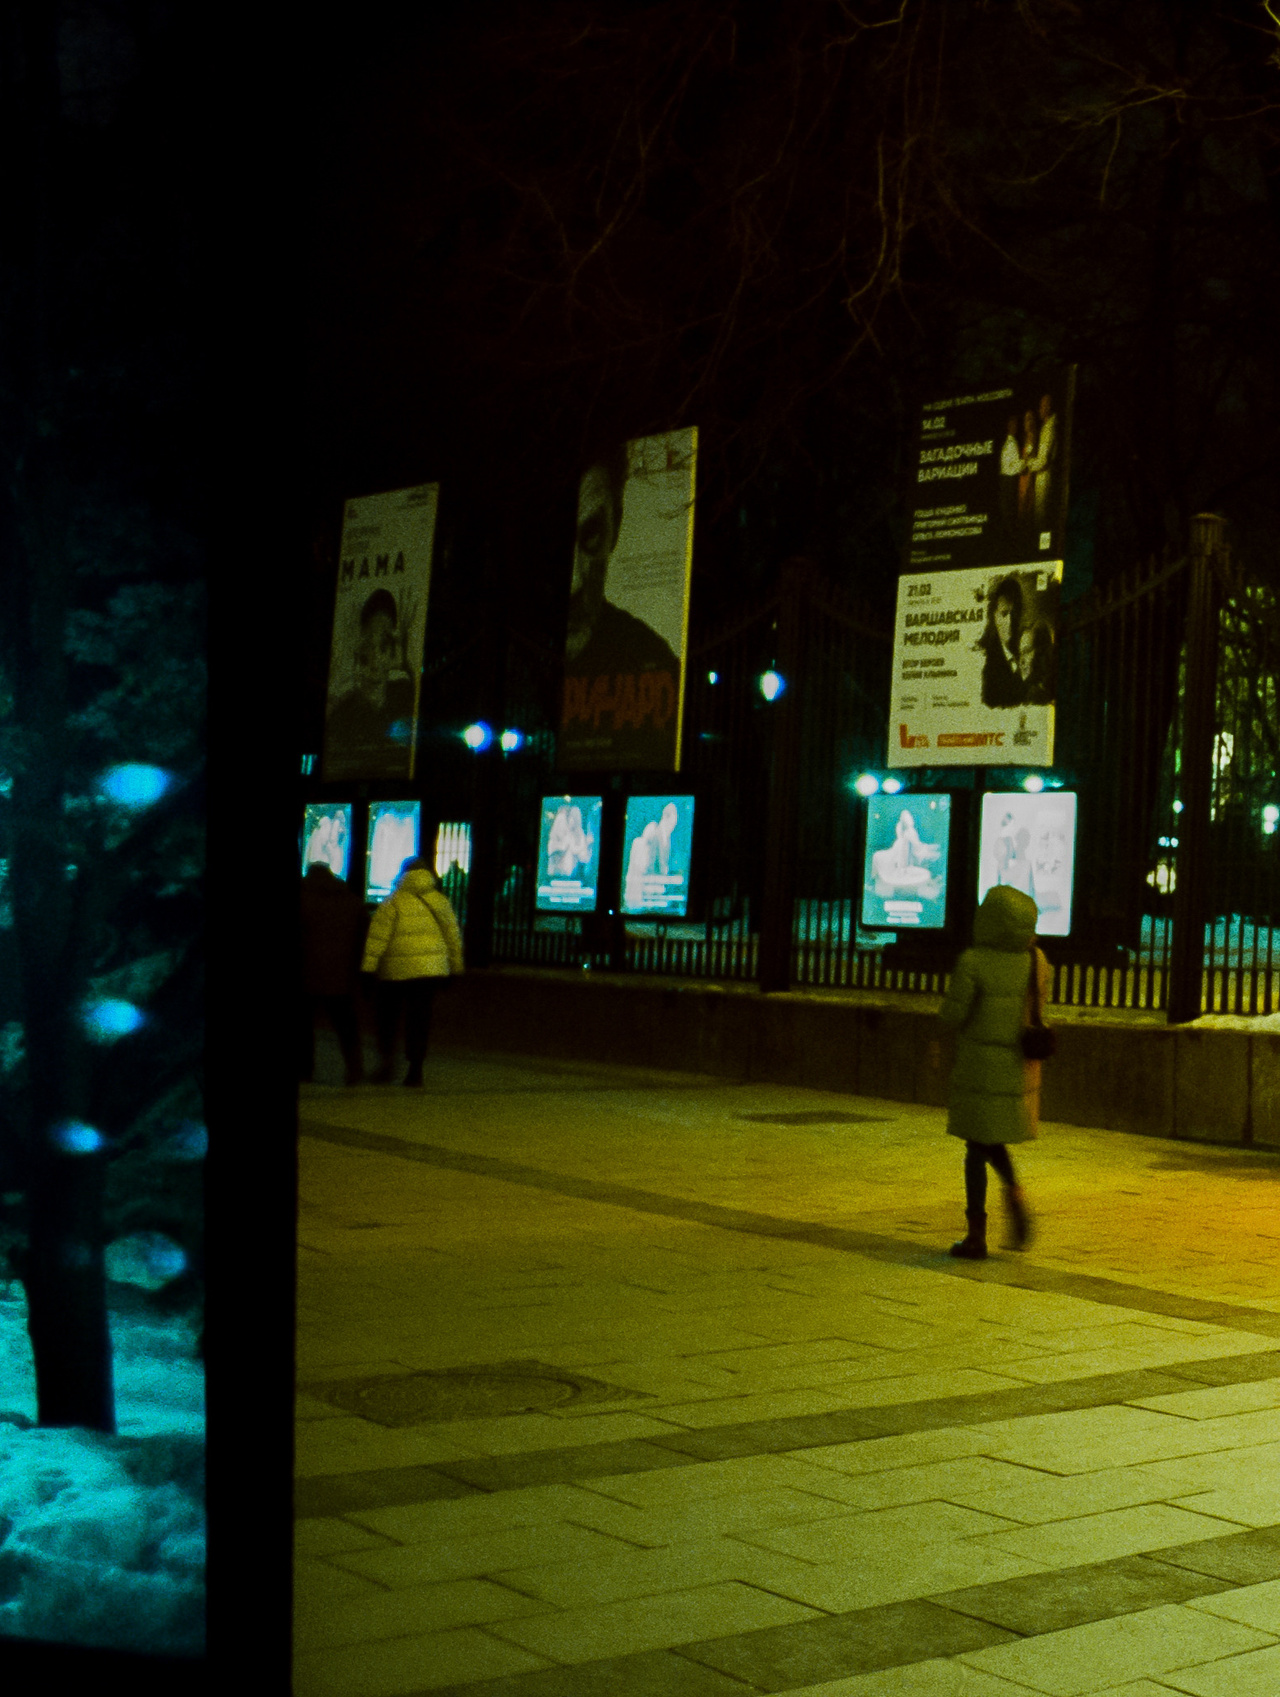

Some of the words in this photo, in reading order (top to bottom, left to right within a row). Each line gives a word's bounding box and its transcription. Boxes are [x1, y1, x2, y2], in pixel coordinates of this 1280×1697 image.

[920, 440, 993, 464] ЗАГАДОЧНЫЕ
[917, 462, 978, 483] ВАРИАЦИИ
[341, 550, 405, 583] МАМА
[907, 583, 932, 597] 21.02
[904, 607, 984, 628] ВАРШАВСКАЯ
[903, 629, 961, 647] МЕЛОДИЯ
